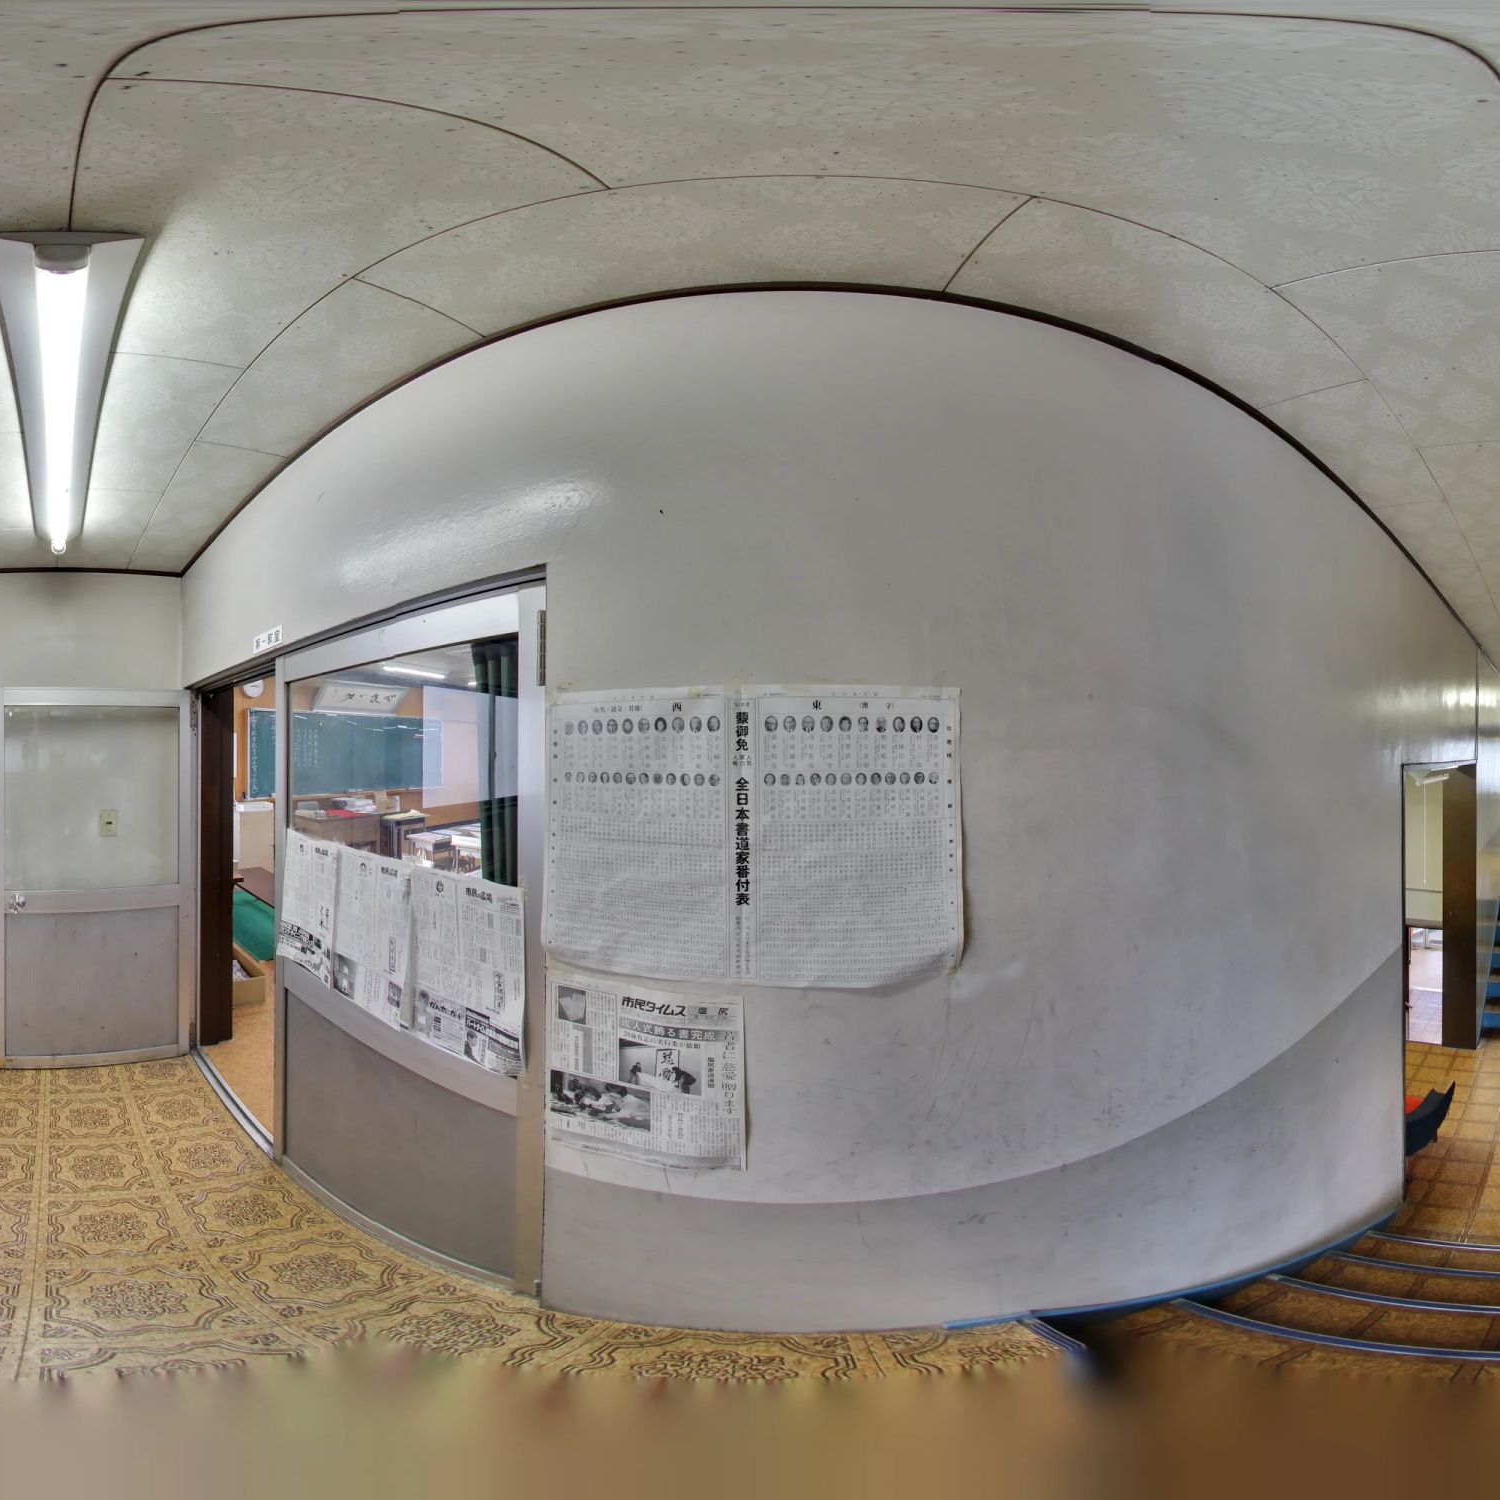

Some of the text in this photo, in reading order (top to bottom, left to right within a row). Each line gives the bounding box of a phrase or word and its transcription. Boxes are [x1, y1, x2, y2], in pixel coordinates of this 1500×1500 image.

[672, 702, 682, 712] 西
[812, 700, 822, 710] 東
[735, 777, 750, 906] 全日本書道家番付表
[621, 996, 687, 1017] 市民タイムス
[621, 1019, 716, 1040] 成人式飾る書完成
